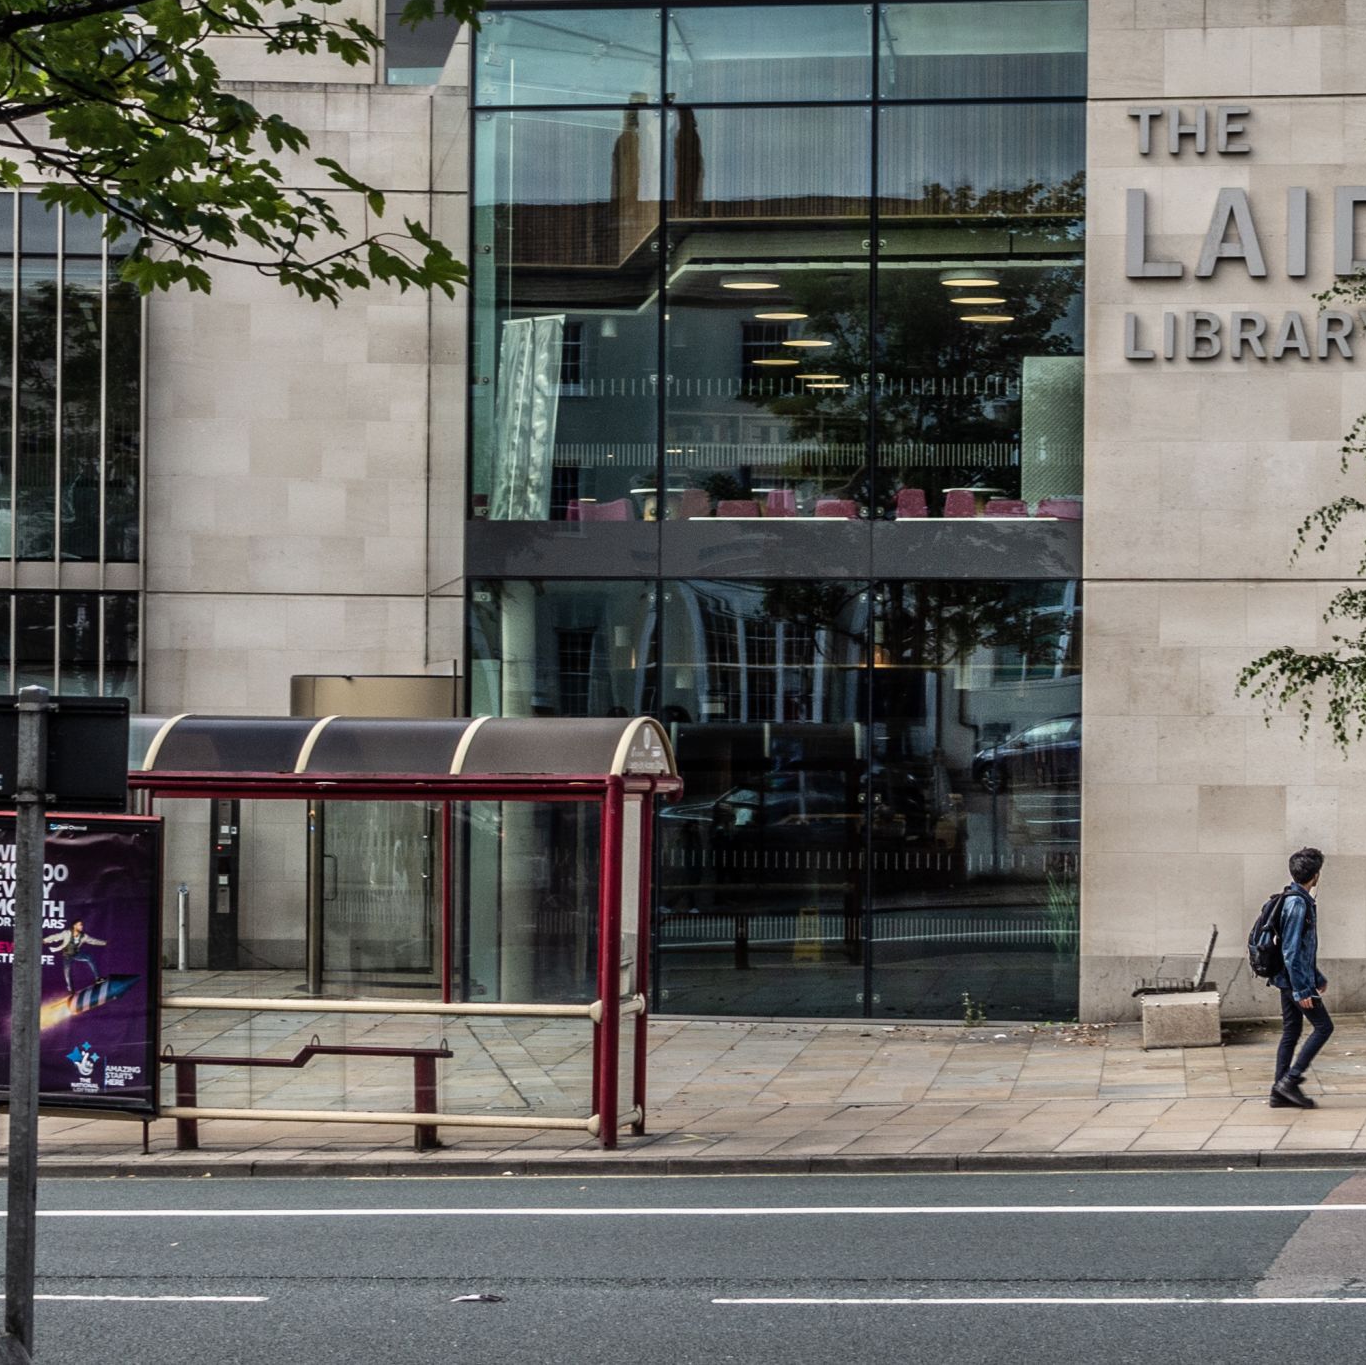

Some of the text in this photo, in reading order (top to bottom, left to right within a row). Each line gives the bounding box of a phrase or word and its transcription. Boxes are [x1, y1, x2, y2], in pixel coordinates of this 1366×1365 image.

[1128, 105, 1251, 156] THE
[106, 1065, 141, 1073] AMAZING
[105, 1072, 133, 1080] STARTS
